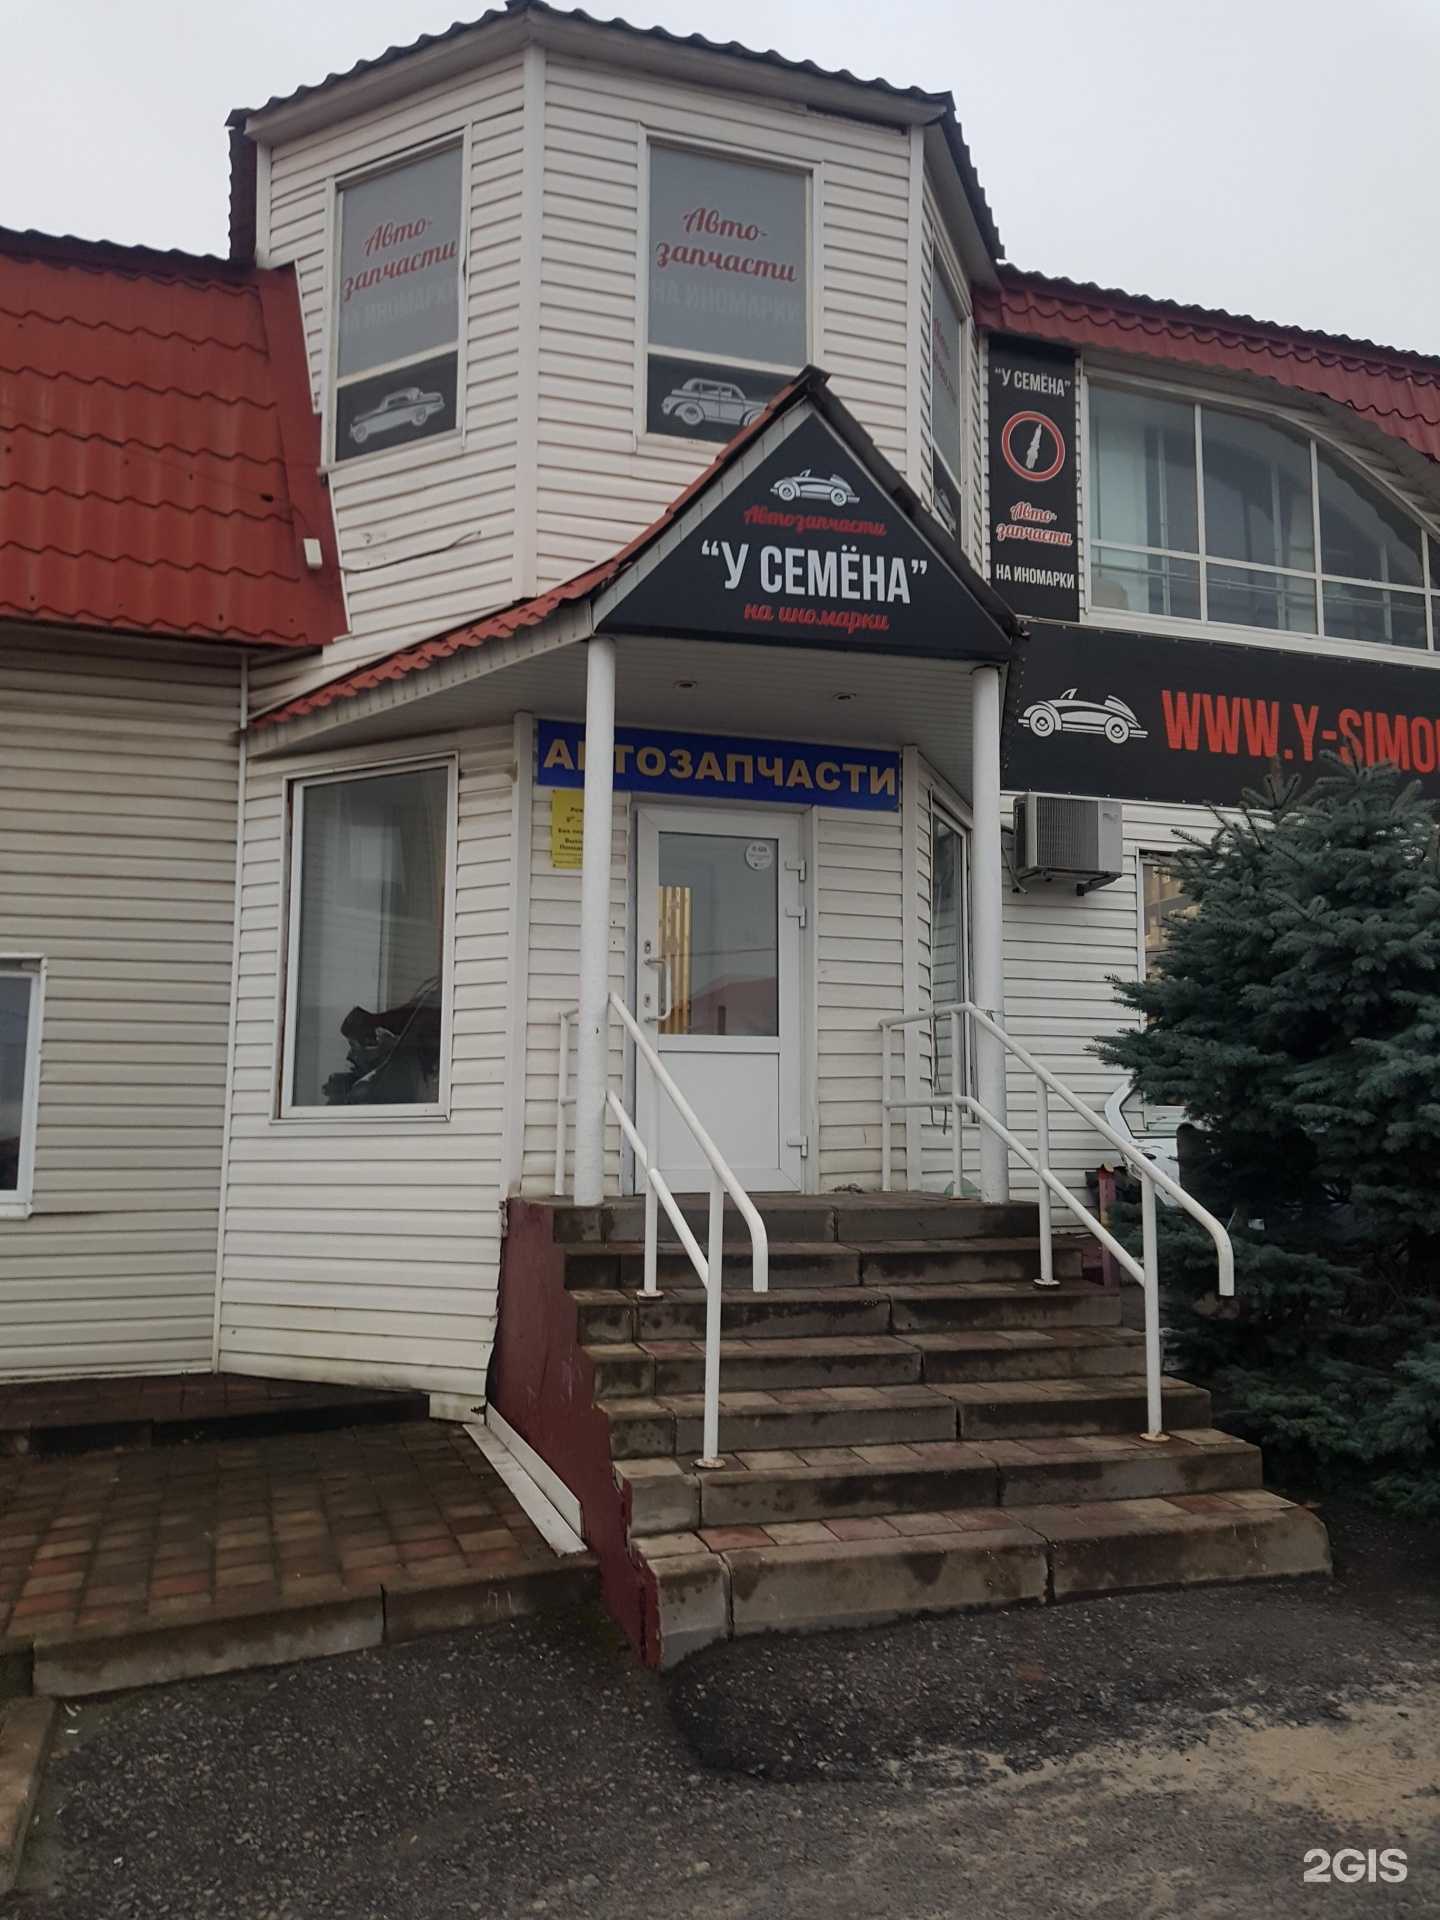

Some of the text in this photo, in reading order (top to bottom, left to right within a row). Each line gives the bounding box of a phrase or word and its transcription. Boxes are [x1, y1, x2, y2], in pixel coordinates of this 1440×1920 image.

[362, 217, 433, 257] Авто-
[682, 206, 768, 241] Авто-
[342, 241, 457, 303] запчасти
[656, 241, 798, 282] запчасти
[743, 504, 887, 536] Автозапчасти
[1009, 500, 1057, 522] Авто-
[996, 522, 1073, 546] запчасти
[996, 563, 1075, 590] НА ИНОМАРКИ
[743, 603, 890, 634] на иномарки
[1161, 689, 1440, 774] WWW.Y-SIMO
